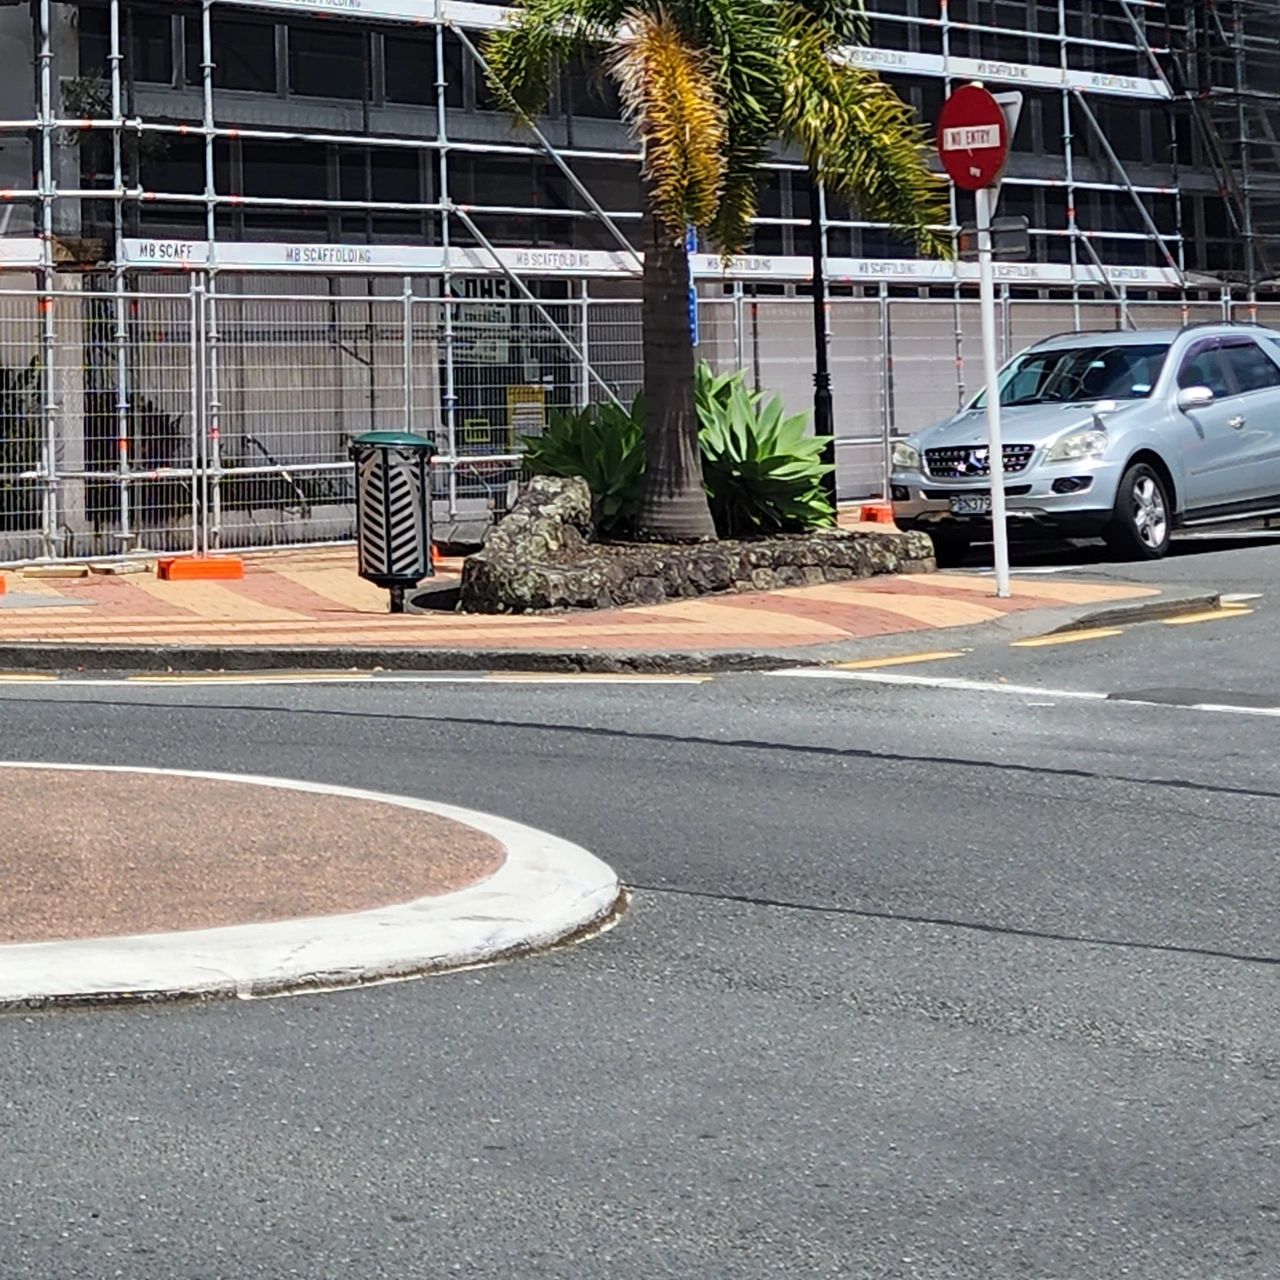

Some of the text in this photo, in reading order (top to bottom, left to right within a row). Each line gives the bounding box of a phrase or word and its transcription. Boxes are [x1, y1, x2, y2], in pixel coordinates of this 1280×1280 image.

[966, 129, 990, 145] ENTRY
[140, 243, 193, 258] MB SCAFF
[286, 249, 370, 263] MB SCAFFOLDING
[531, 252, 589, 266] SCAFFOLDING
